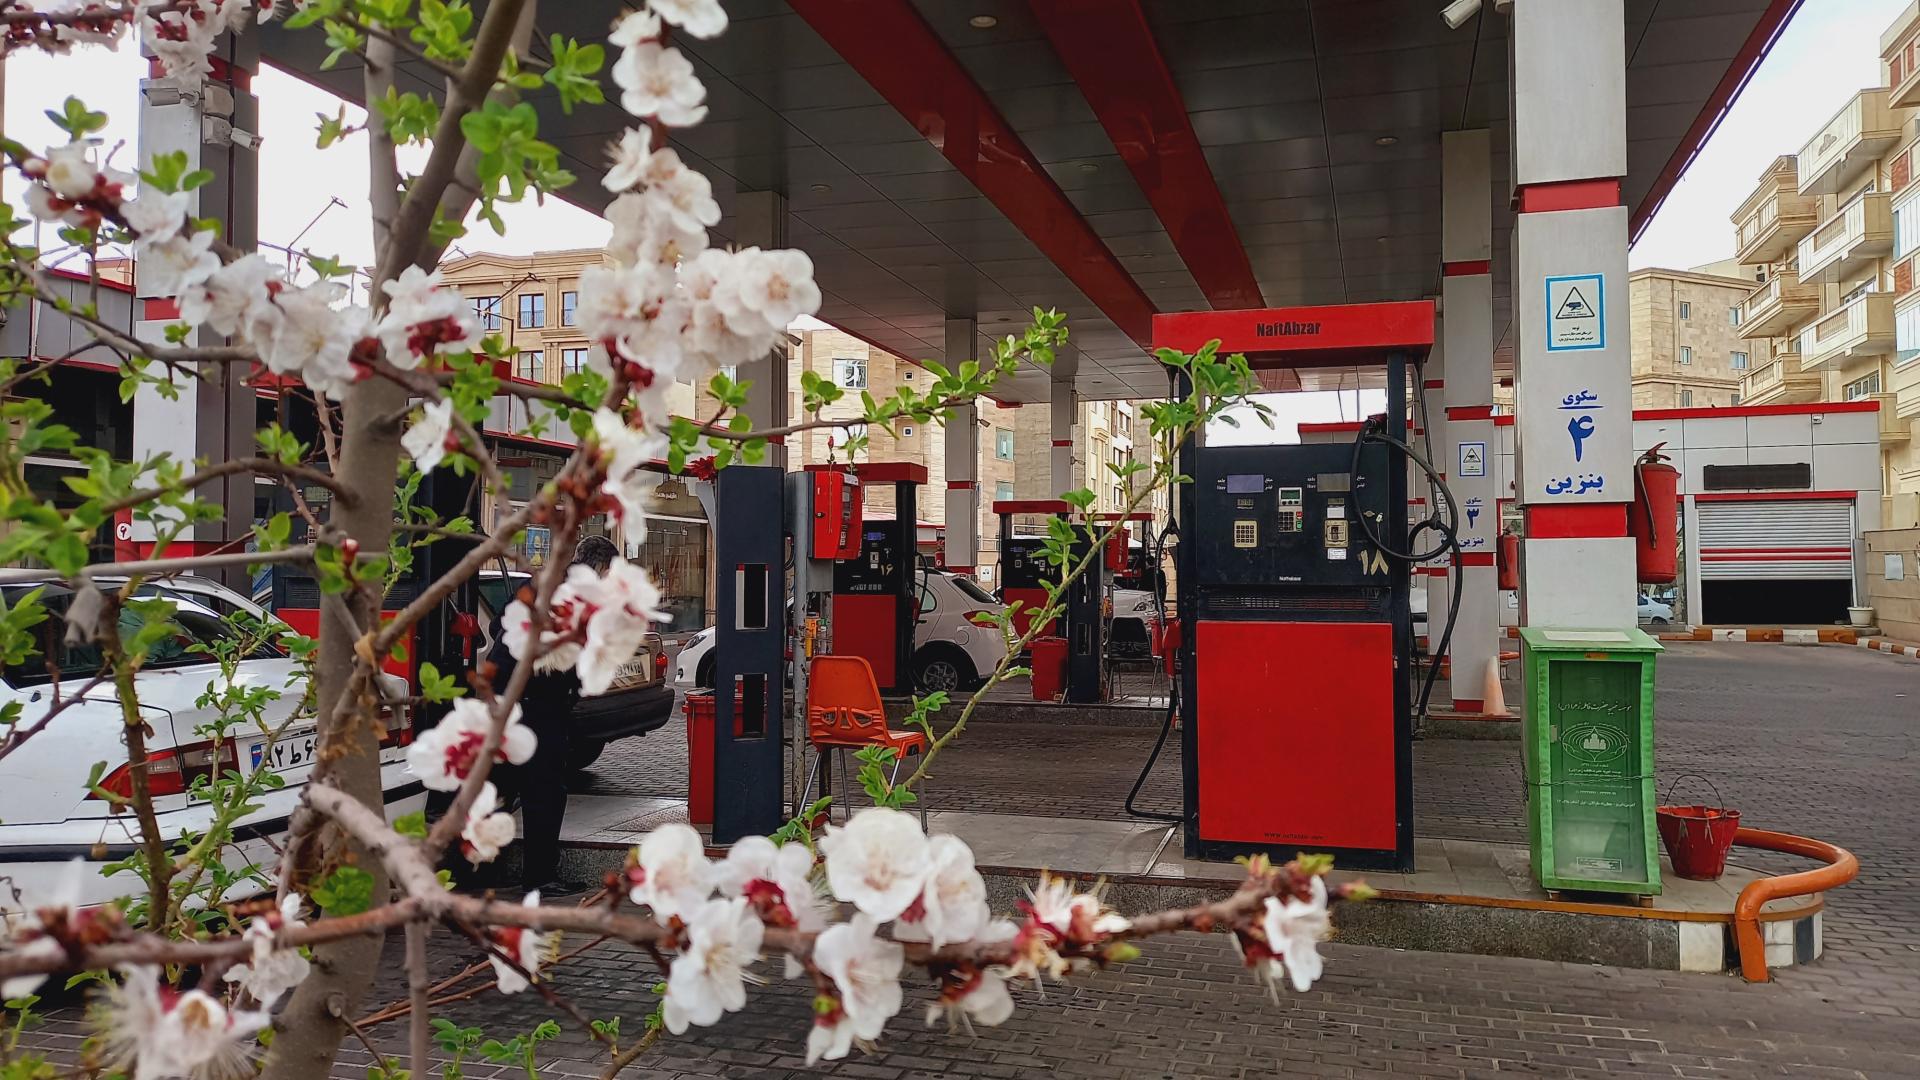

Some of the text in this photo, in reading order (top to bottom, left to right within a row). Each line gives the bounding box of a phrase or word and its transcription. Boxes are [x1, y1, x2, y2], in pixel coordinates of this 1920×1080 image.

[1256, 321, 1321, 337] NaftAbzar
[1562, 389, 1598, 406] سکوی
[1567, 415, 1595, 463] ۴
[1545, 471, 1605, 495] بنزین
[1465, 495, 1482, 505] سکوی
[1466, 508, 1480, 530] ۳
[1458, 536, 1485, 548] بنزین
[880, 563, 893, 576] ۱۶
[1360, 549, 1389, 576] ۱۸
